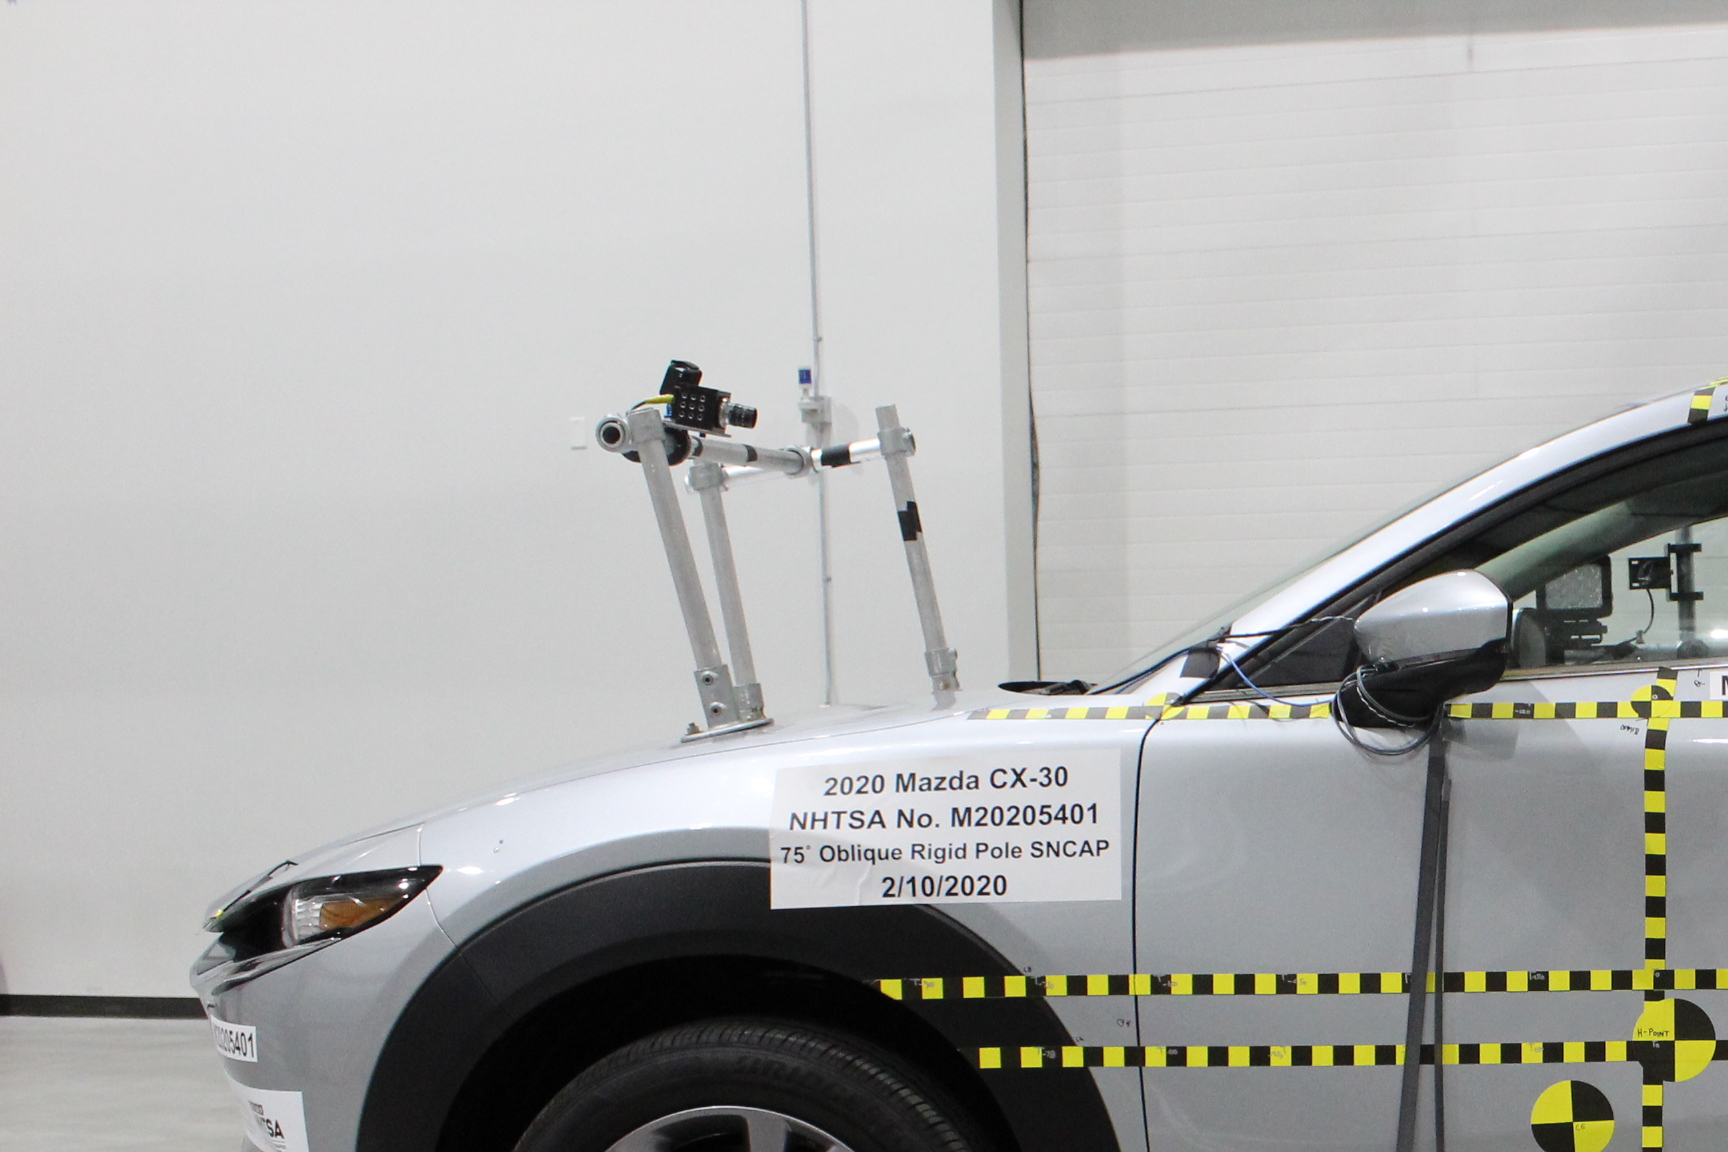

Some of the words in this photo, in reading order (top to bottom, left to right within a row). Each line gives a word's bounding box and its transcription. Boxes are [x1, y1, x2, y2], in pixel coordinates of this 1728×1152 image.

[824, 774, 885, 796] 2020
[895, 770, 980, 793] Mazda
[989, 765, 1068, 790] CX-30
[789, 809, 887, 831] NHTSA
[896, 808, 940, 829] No.
[951, 802, 1097, 828] M20205401
[819, 843, 903, 866] Oblique
[910, 842, 967, 865] Rigid
[975, 840, 1023, 860] Pole
[1029, 839, 1110, 859] SNCAP
[881, 874, 1007, 898] 2/10/2020
